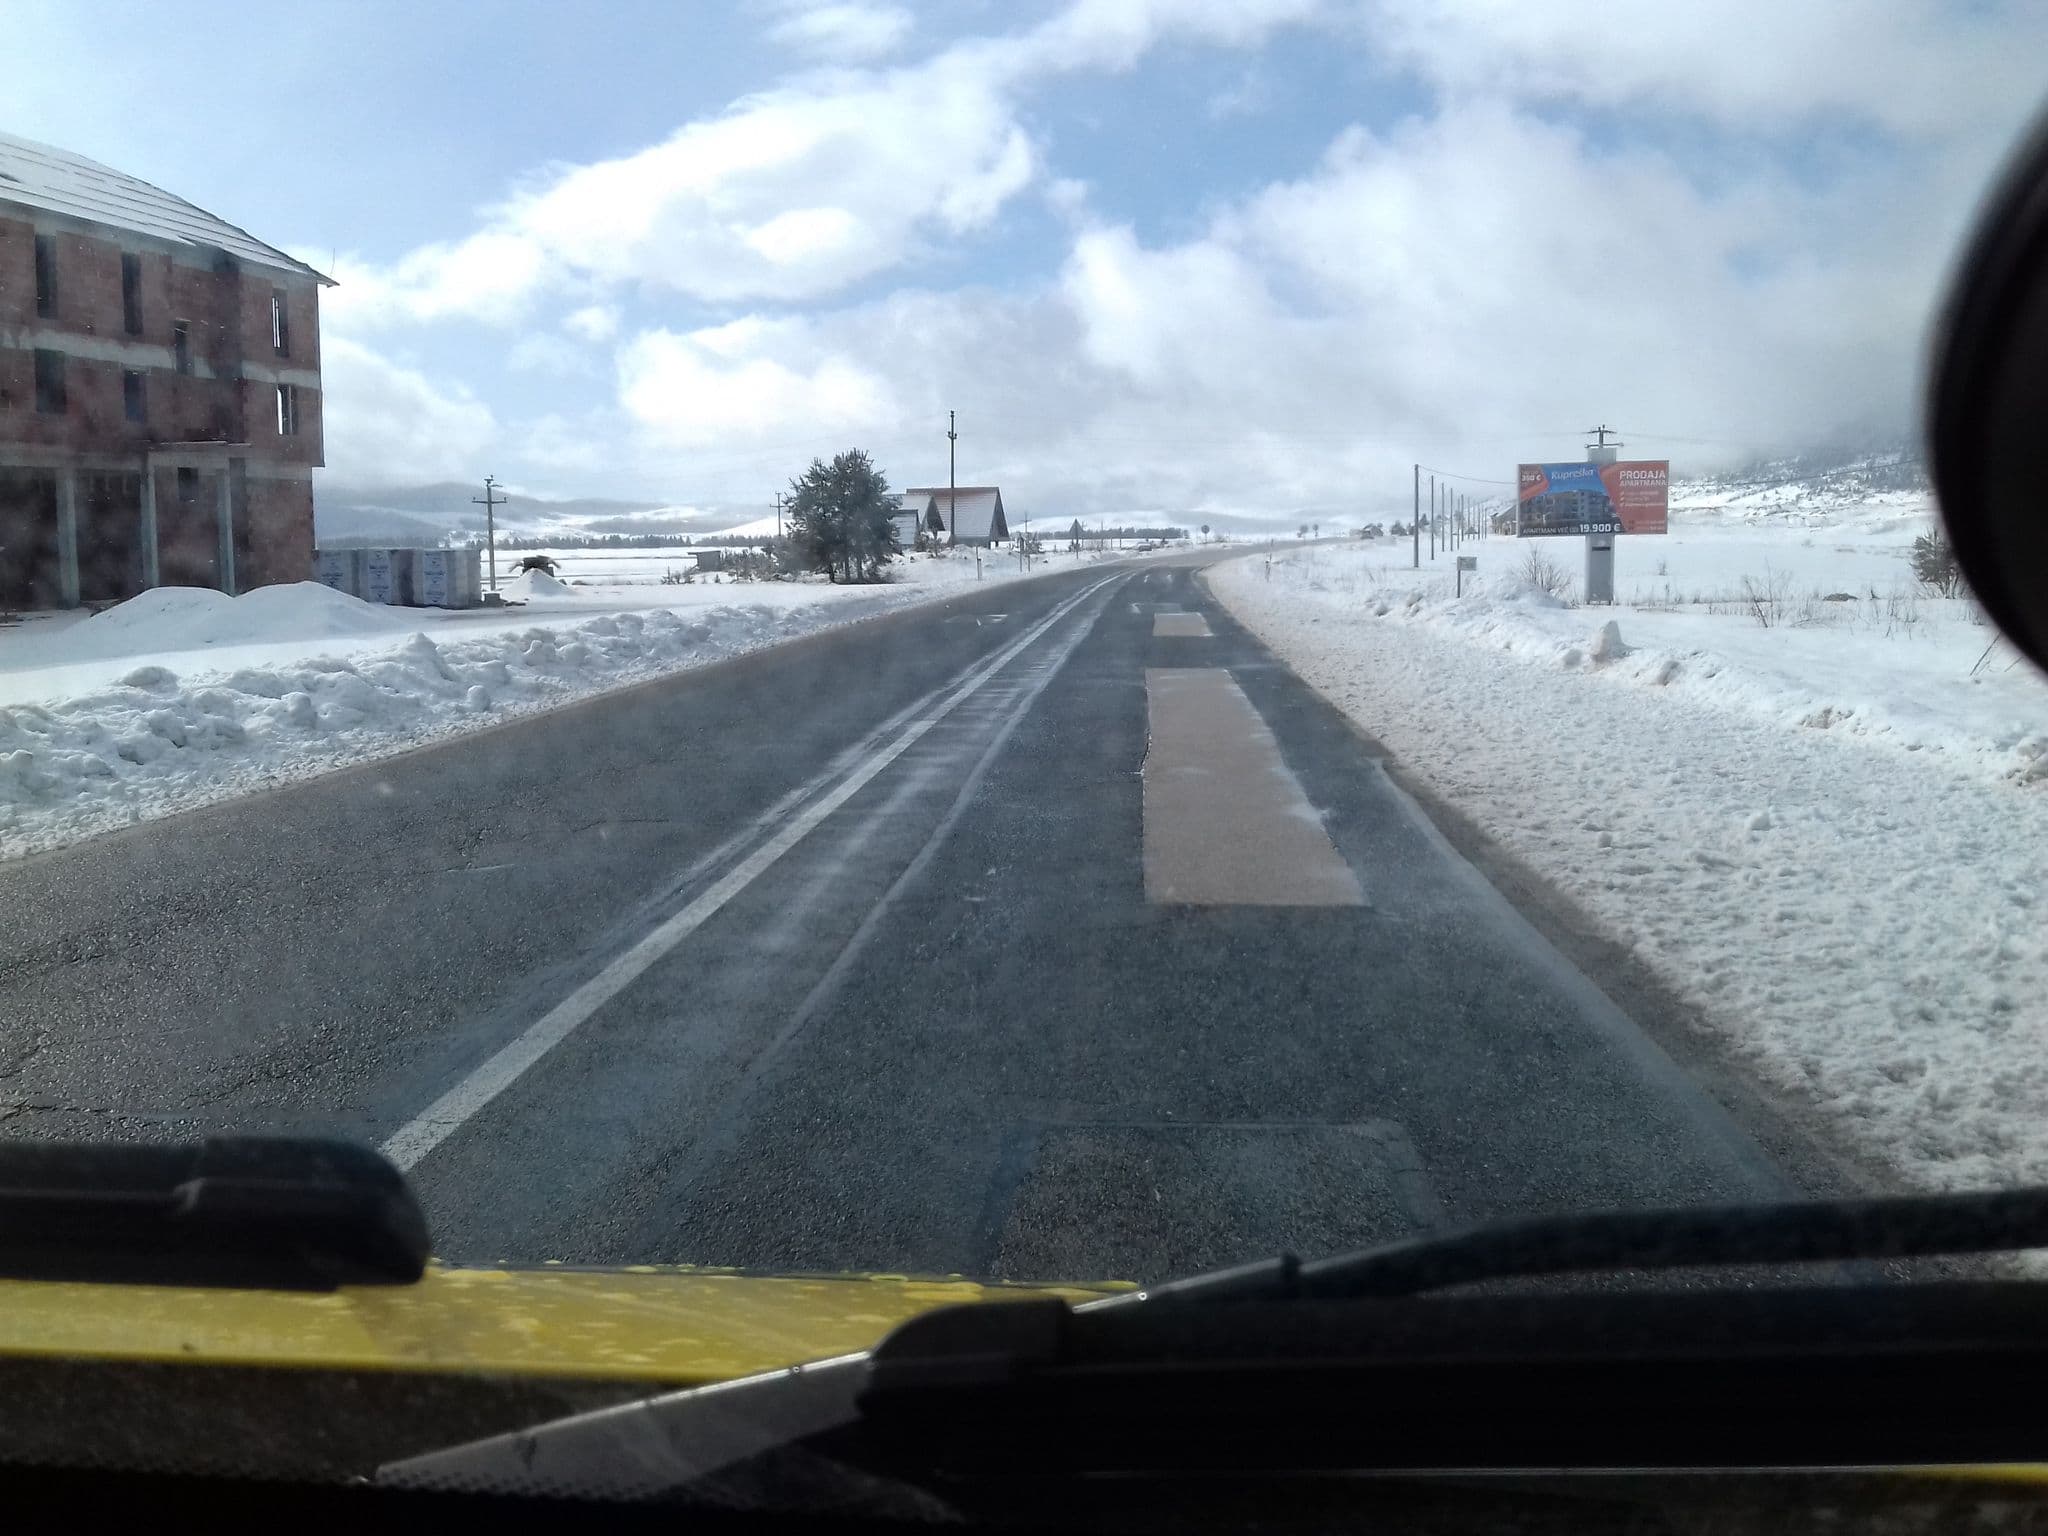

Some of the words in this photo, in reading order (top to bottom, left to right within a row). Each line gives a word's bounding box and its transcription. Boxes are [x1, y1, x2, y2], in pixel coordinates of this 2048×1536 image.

[1619, 470, 1666, 480] PRODAJA
[1619, 479, 1667, 488] APARTMANA
[1579, 523, 1611, 533] 19.900
[1613, 523, 1621, 532] €
